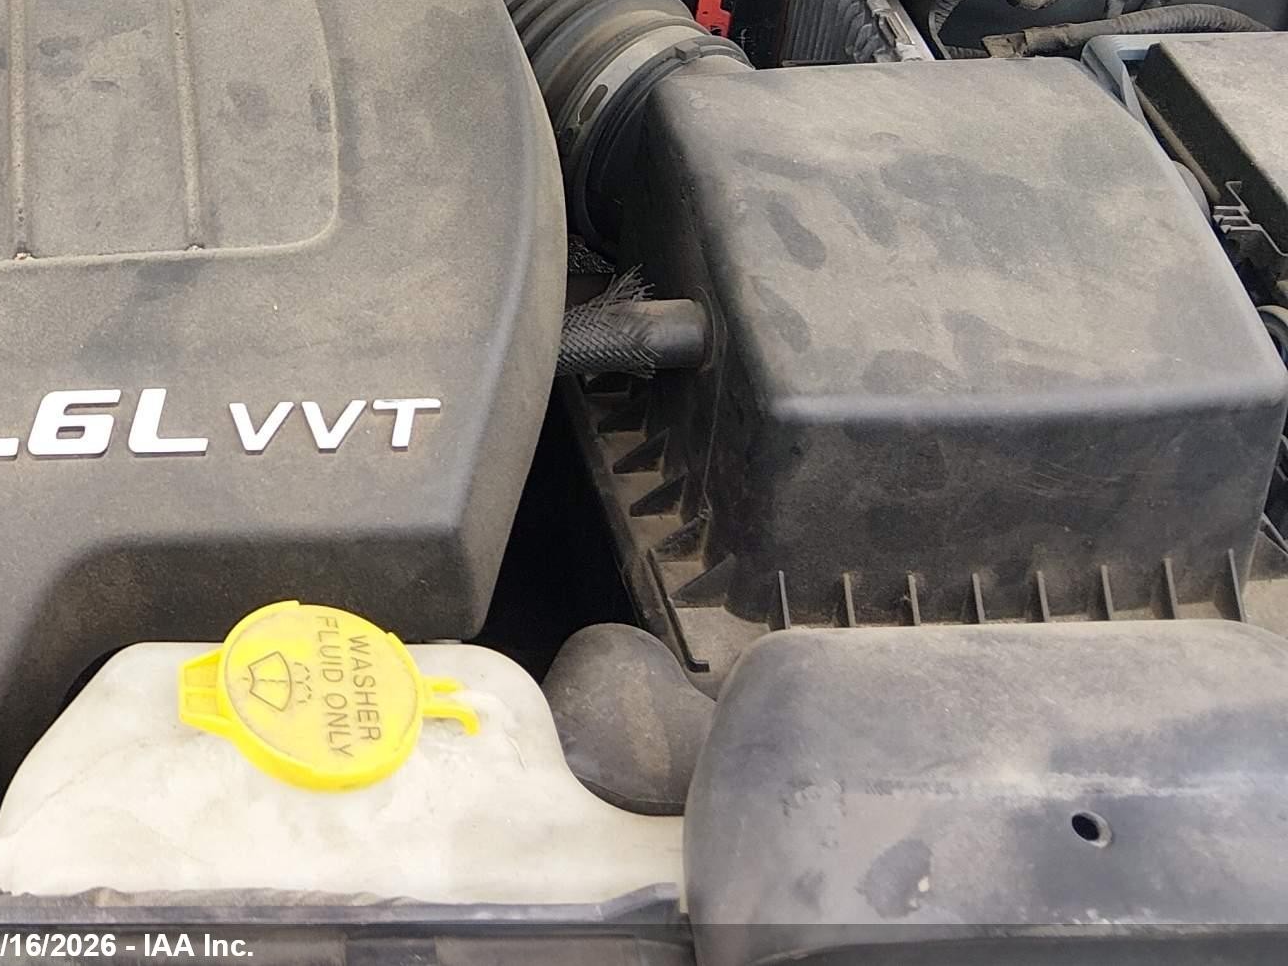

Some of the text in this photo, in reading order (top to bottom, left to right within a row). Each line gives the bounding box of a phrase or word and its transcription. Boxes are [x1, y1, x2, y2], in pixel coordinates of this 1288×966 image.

[228, 398, 441, 456] VVT
[316, 615, 355, 758] FLUID ONLY
[348, 635, 382, 741] WASHER
